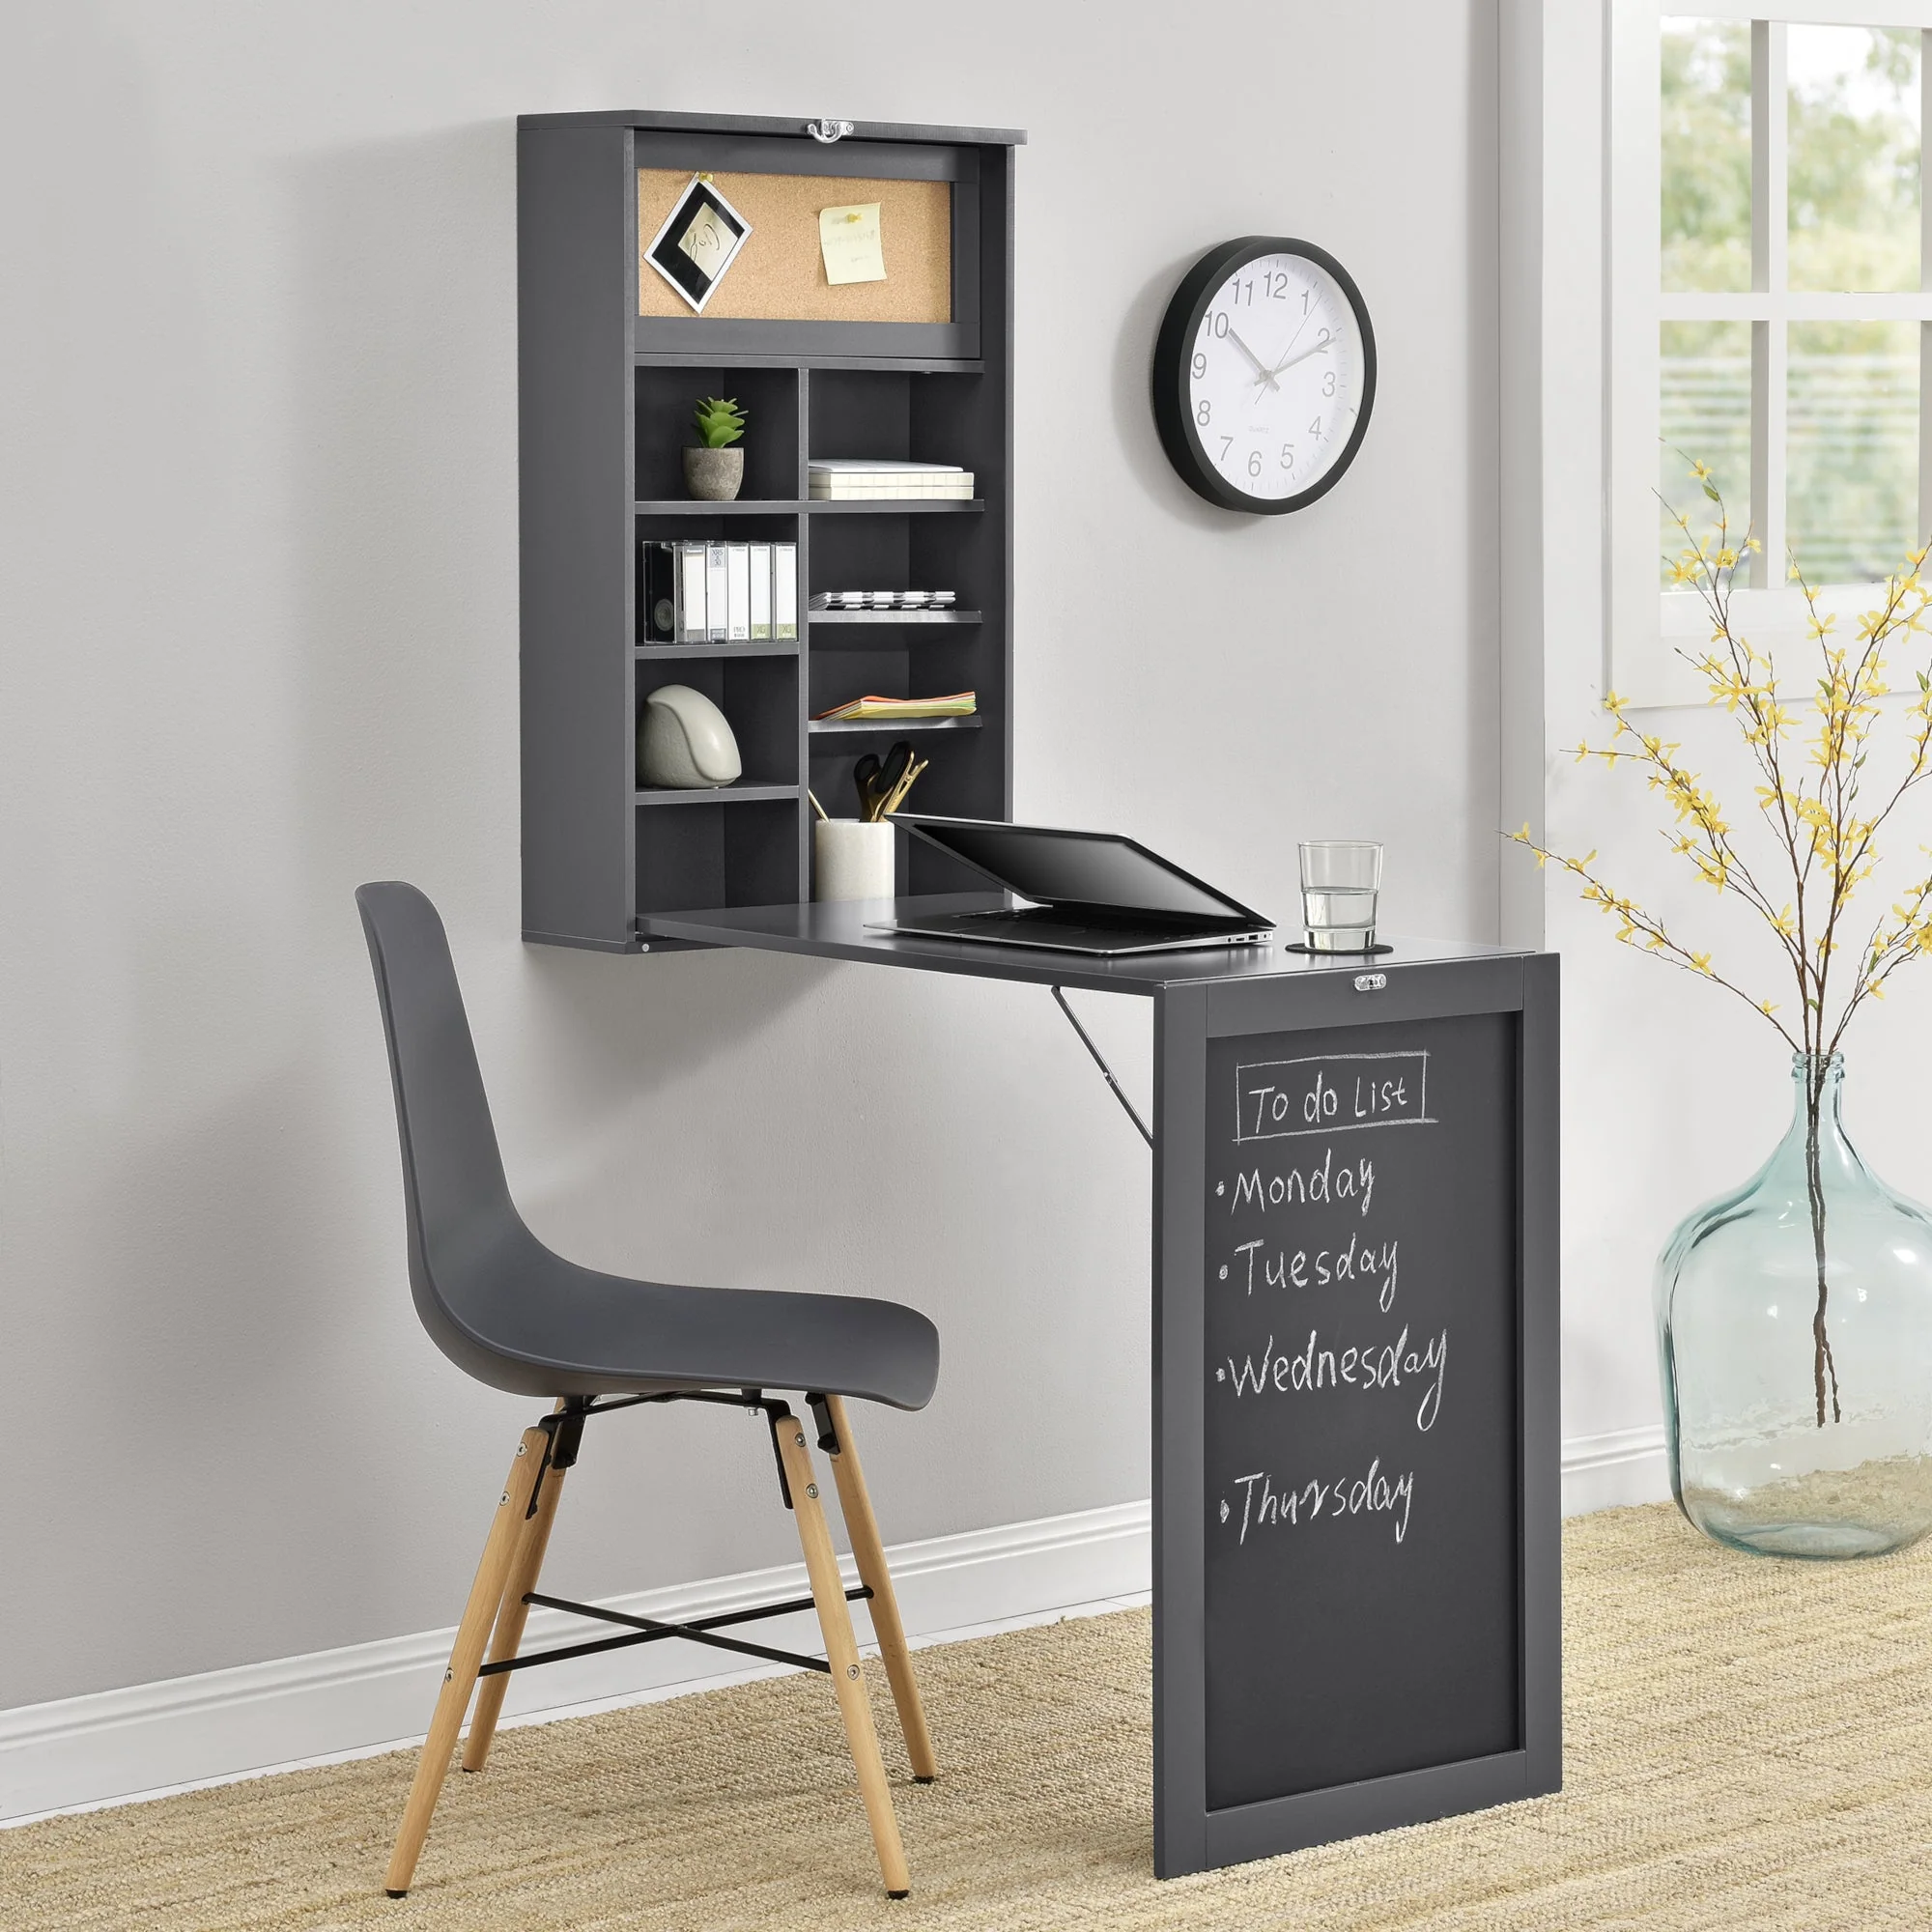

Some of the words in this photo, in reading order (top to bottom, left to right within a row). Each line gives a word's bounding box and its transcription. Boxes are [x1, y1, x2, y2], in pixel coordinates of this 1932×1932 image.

[1232, 278, 1255, 306] 11
[1264, 270, 1290, 299] 12
[1301, 290, 1310, 316] 1
[1205, 311, 1230, 339] 10
[1317, 327, 1332, 354] 2
[1192, 353, 1207, 380] 9
[1322, 371, 1336, 397] 3
[1197, 400, 1210, 426] 8
[1309, 415, 1321, 441] 4
[1220, 435, 1234, 462] 7
[1280, 443, 1295, 469] 5
[1248, 450, 1263, 477] 6
[1249, 1086, 1290, 1134] To
[1304, 1070, 1338, 1123] do
[1354, 1076, 1408, 1118] List
[1232, 1149, 1375, 1216] Monday
[1234, 1232, 1399, 1313] Tuesday
[1227, 1323, 1447, 1432] Wednesday
[1234, 1456, 1414, 1545] Thursday
